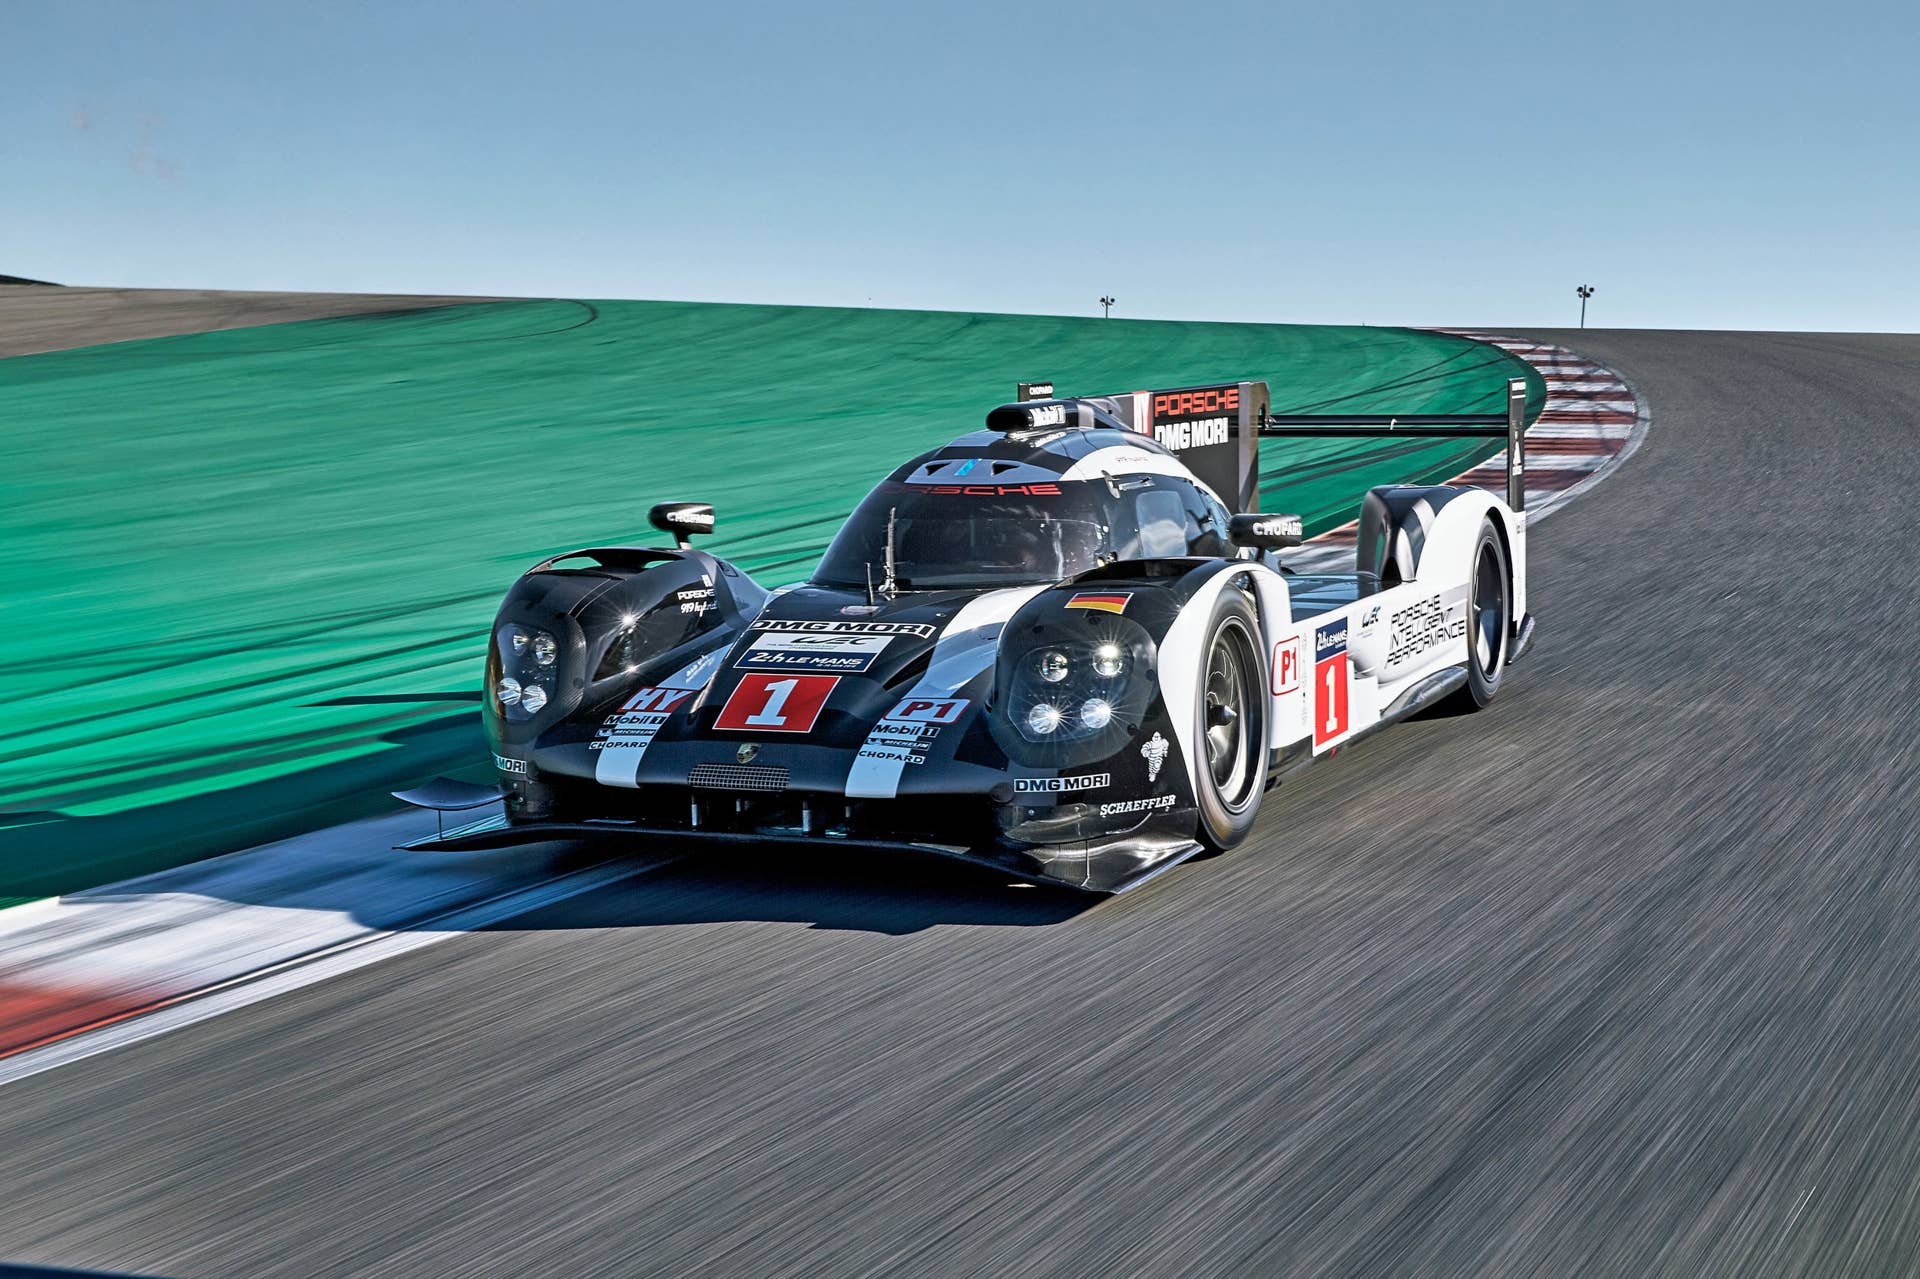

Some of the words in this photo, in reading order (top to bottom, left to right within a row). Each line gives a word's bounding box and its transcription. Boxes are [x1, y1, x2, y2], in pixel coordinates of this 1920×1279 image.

[1154, 389, 1239, 417] PORSCHE
[1154, 423, 1191, 451] DMG
[1191, 417, 1229, 448] MORI
[1252, 521, 1303, 536] CHOPARD
[677, 589, 716, 600] PORSCHE
[680, 602, 694, 614] 919
[1390, 594, 1440, 627] PORSCHE
[752, 621, 829, 631] DMG
[832, 622, 932, 637] MORI
[1389, 607, 1453, 651] INTELLIGENT
[790, 636, 877, 646] WEC
[1384, 620, 1465, 669] PERFORMANCE
[785, 656, 811, 664] LE
[808, 657, 865, 666] MANS
[1281, 647, 1297, 685] P1
[621, 688, 694, 711] HY
[744, 679, 799, 726] 1
[1326, 665, 1338, 734] 1
[899, 701, 957, 718] P1
[604, 715, 650, 725] Mobil
[873, 724, 922, 736] Mobil
[590, 741, 648, 749] CHOPARD
[884, 740, 929, 749] MICHELIN
[498, 756, 527, 773] MORI
[858, 750, 923, 763] CHOPARD
[1015, 778, 1061, 792] DMG
[1064, 774, 1109, 790] MORI
[1100, 795, 1177, 816] SCHAEFFLER
